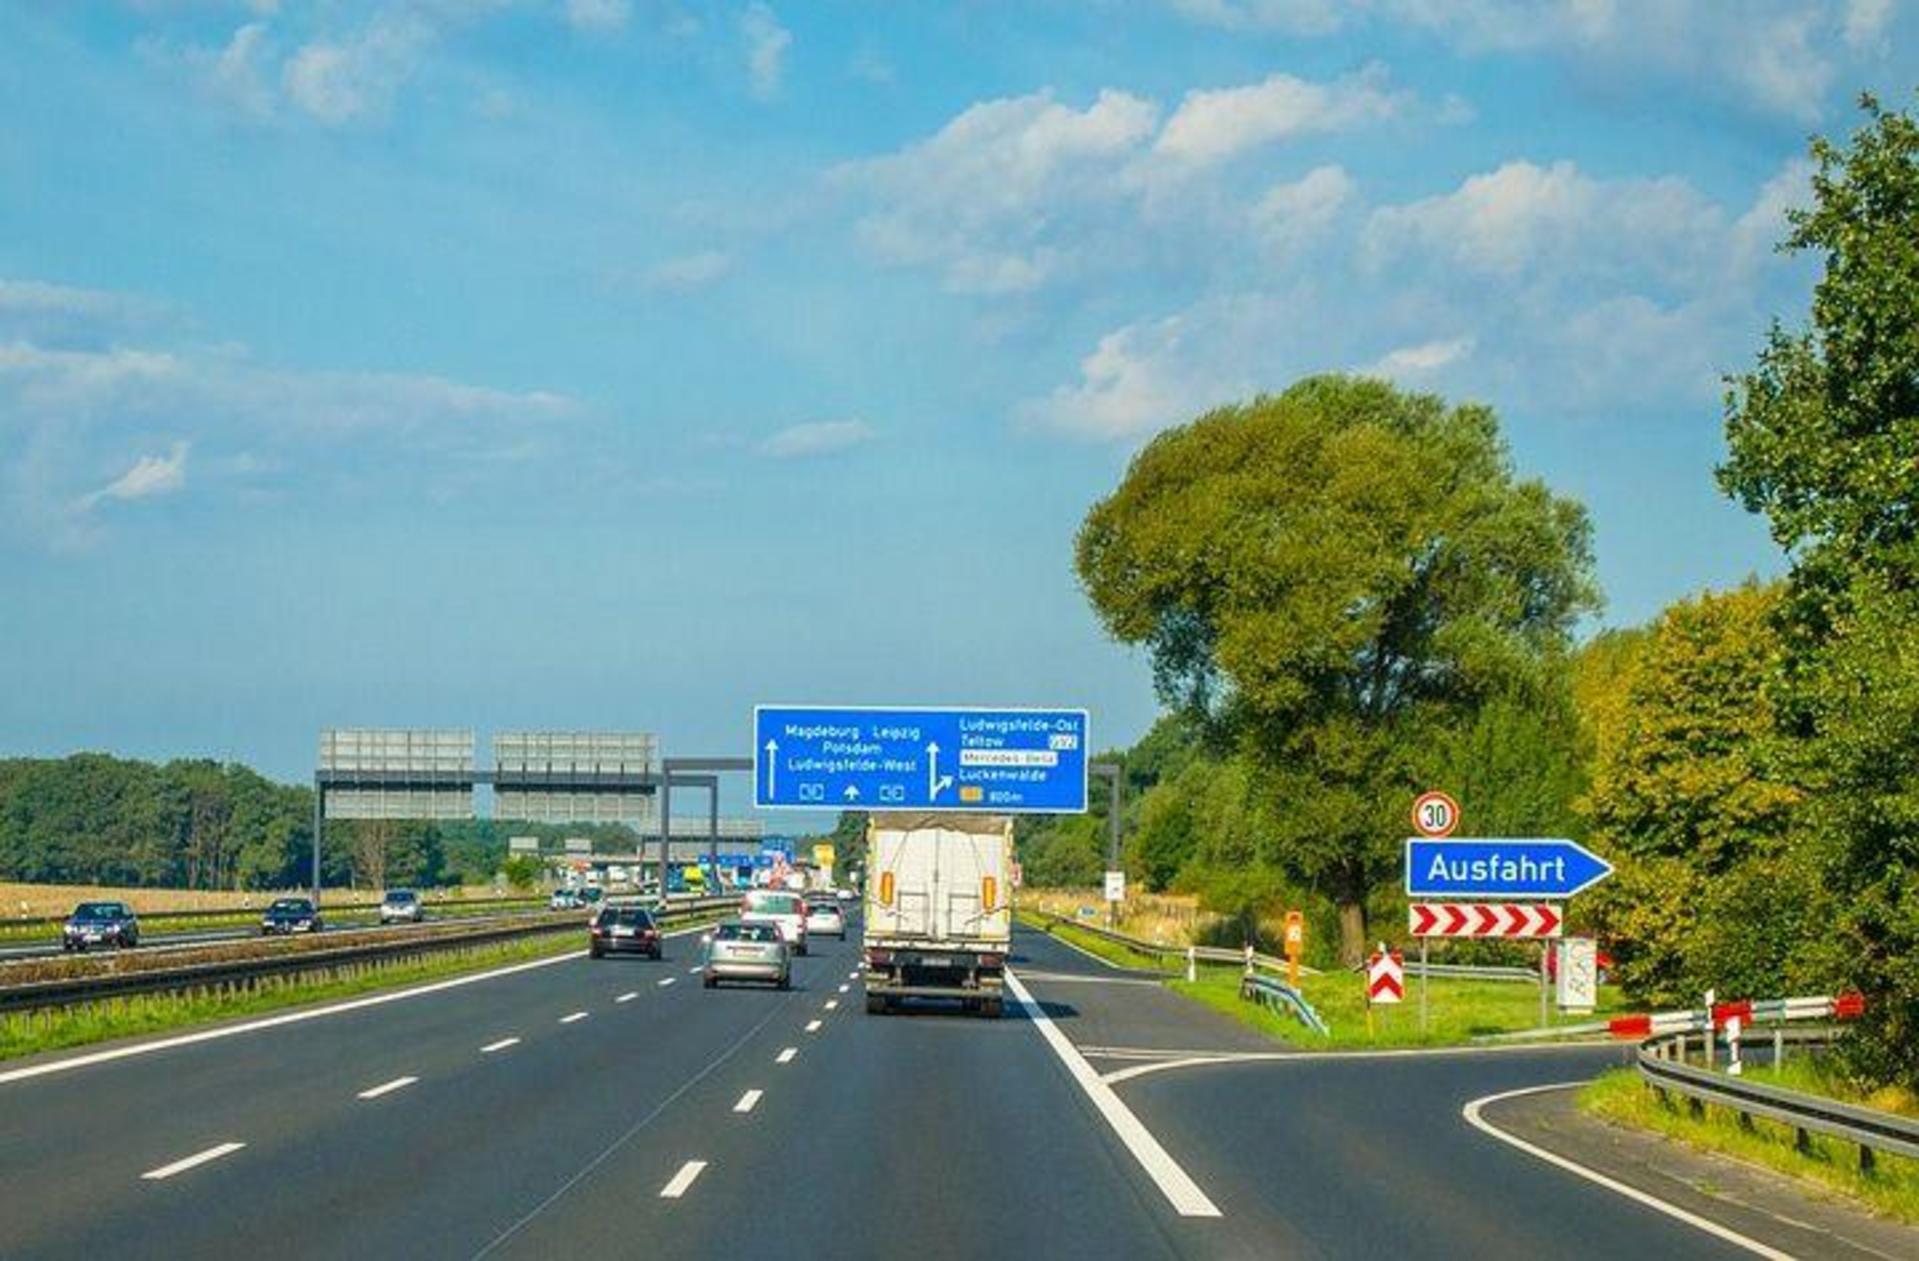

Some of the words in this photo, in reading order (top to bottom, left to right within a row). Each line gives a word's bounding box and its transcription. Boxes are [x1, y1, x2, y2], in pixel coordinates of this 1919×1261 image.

[785, 725, 859, 740] Magdeburg
[872, 726, 920, 741] Leipzig
[959, 718, 1078, 733] Ludwigsfelde-Ost
[823, 741, 881, 754] Potsdam
[788, 758, 917, 773] Ludwigsfelde-West
[959, 767, 1046, 781] Luckenwalde
[1425, 804, 1447, 827] 30
[1428, 854, 1565, 881] Ausfahrt
